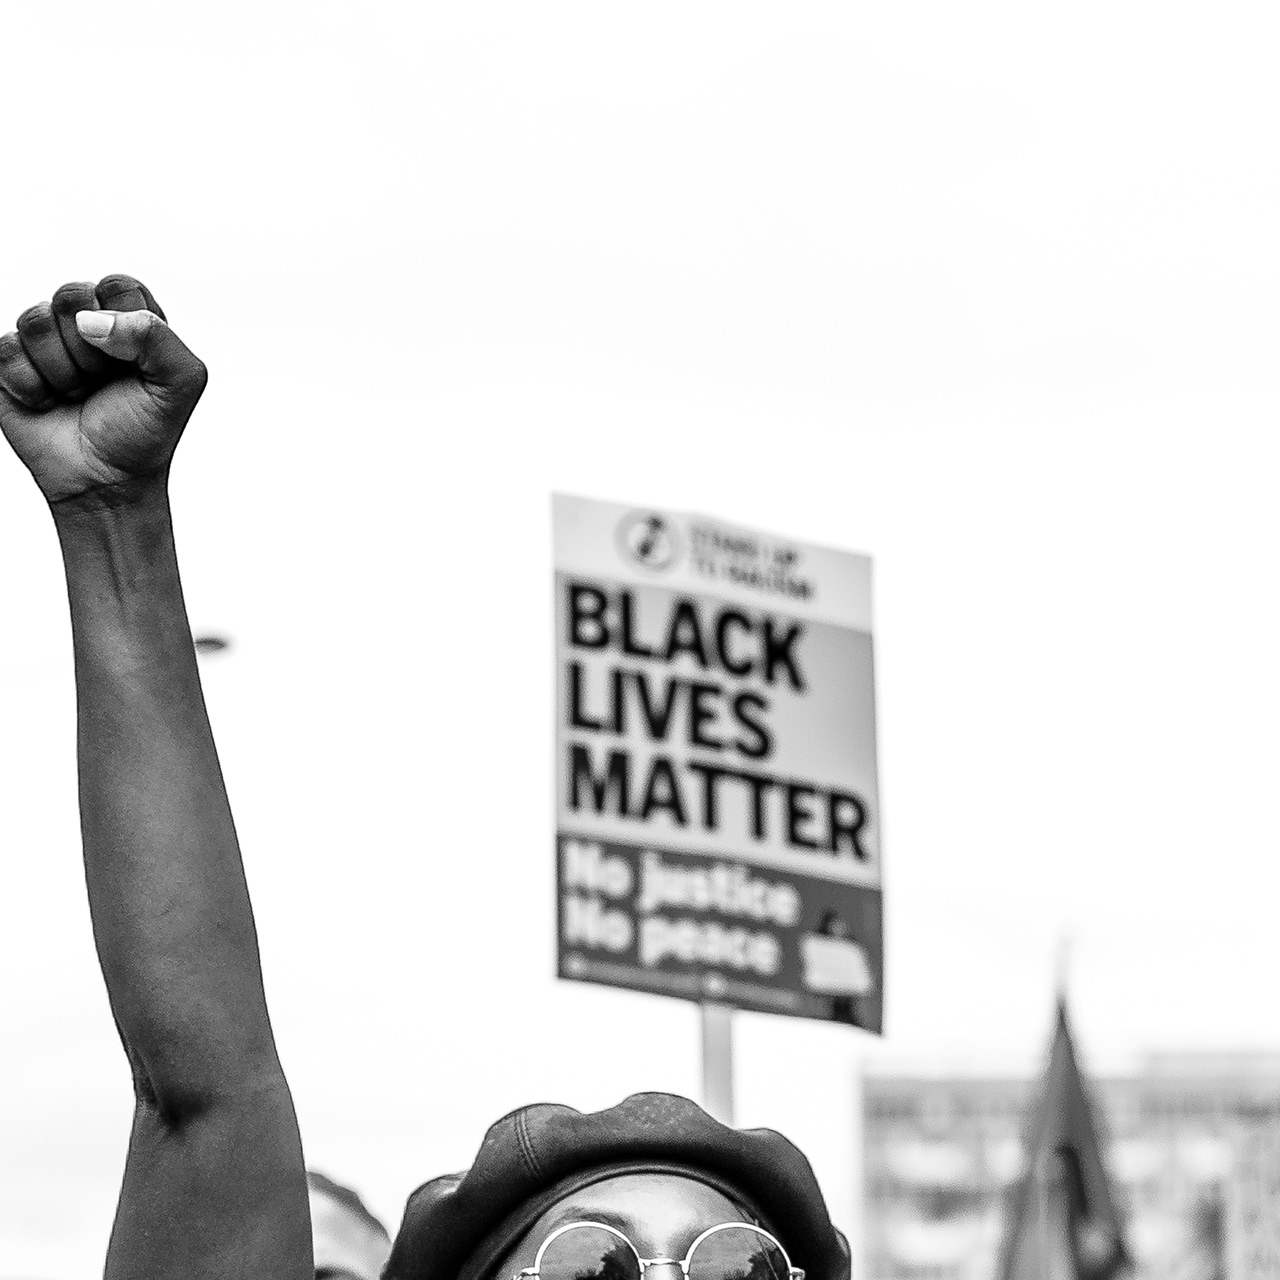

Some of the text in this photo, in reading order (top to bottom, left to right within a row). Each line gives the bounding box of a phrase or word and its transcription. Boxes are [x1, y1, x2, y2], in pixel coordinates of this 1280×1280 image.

[568, 583, 806, 693] BLACK
[569, 659, 771, 759] LIVES
[569, 743, 868, 861] MATTER
[564, 841, 632, 897] No
[564, 895, 632, 950] No
